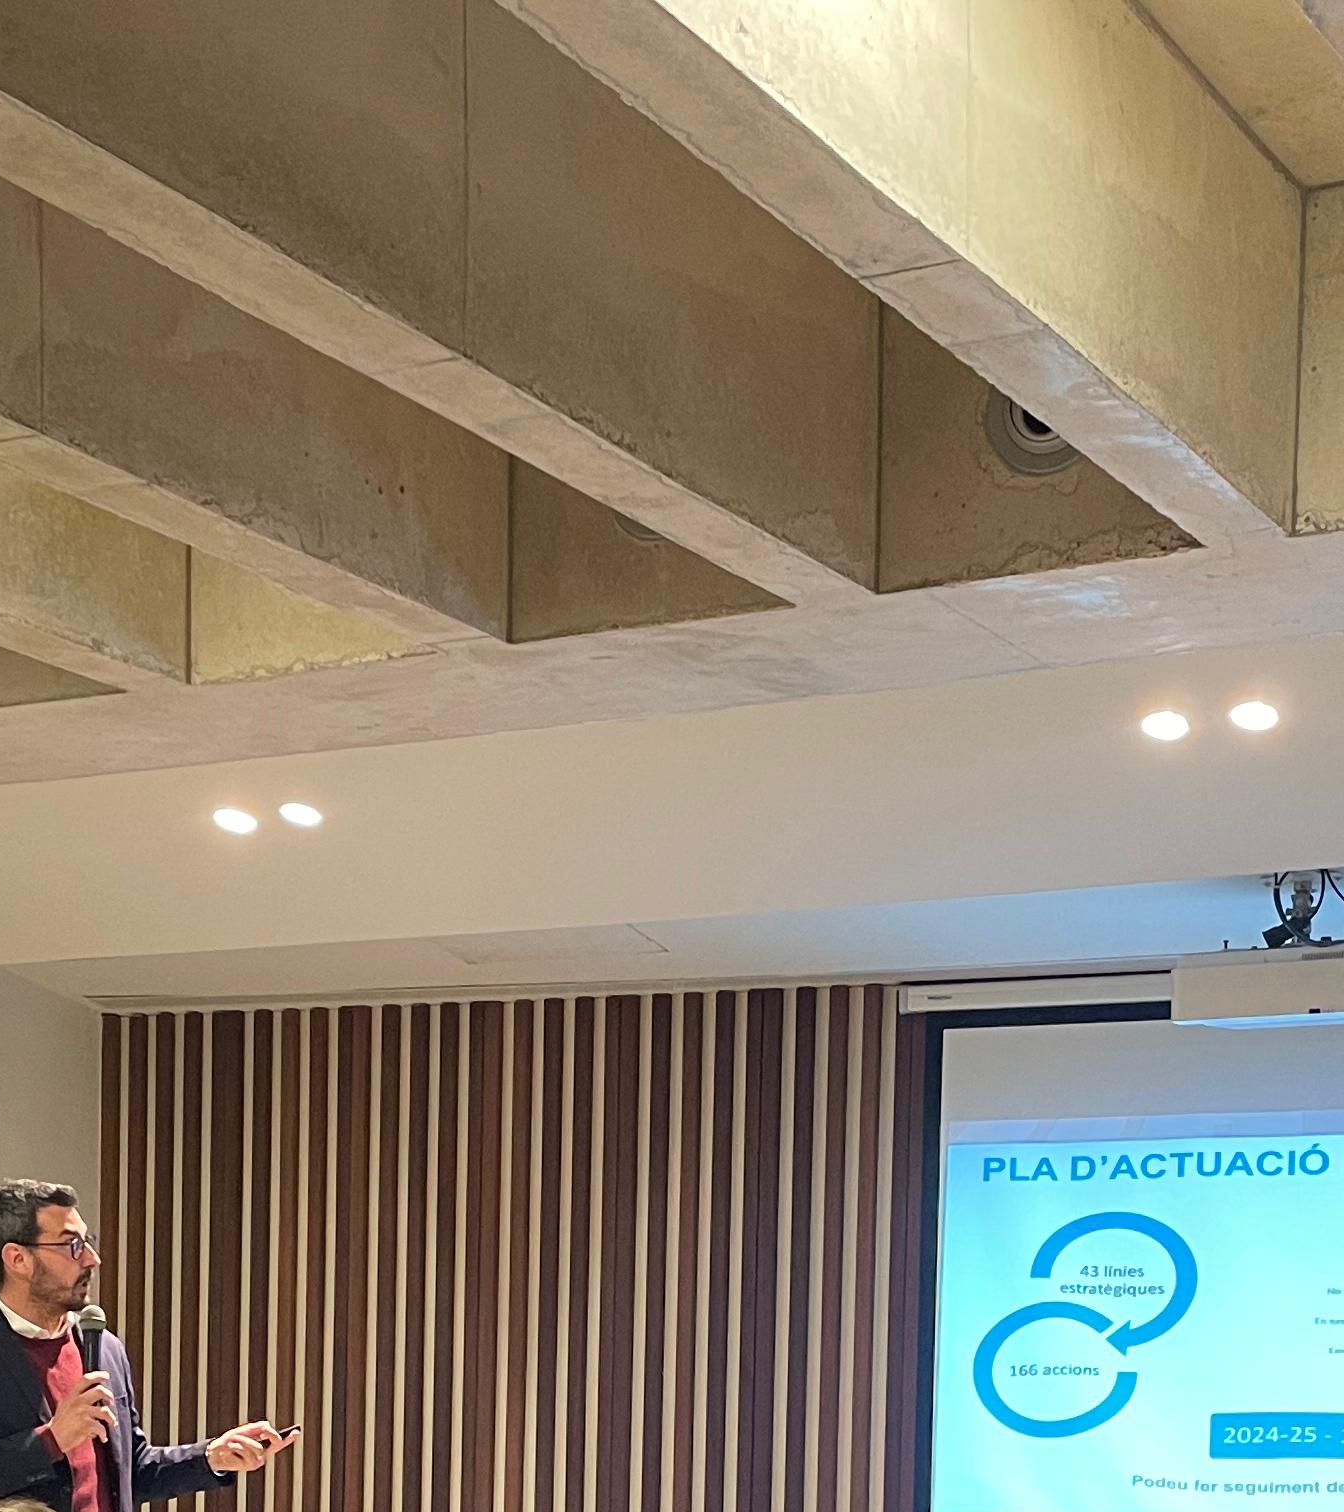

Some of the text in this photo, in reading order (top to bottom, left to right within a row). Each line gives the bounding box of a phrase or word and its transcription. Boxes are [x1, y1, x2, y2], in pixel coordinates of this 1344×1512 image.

[983, 1157, 1057, 1182] PLA
[1071, 1143, 1329, 1181] D'ACTUACIÓ
[1080, 1266, 1144, 1277] 43 línies
[1060, 1283, 1165, 1297] estratègiques
[1011, 1364, 1099, 1376] 166 accions
[1224, 1427, 1316, 1443] 2024-25
[1132, 1475, 1187, 1490] Podeu
[1195, 1480, 1217, 1492] fer
[1224, 1480, 1319, 1495] seguiment
